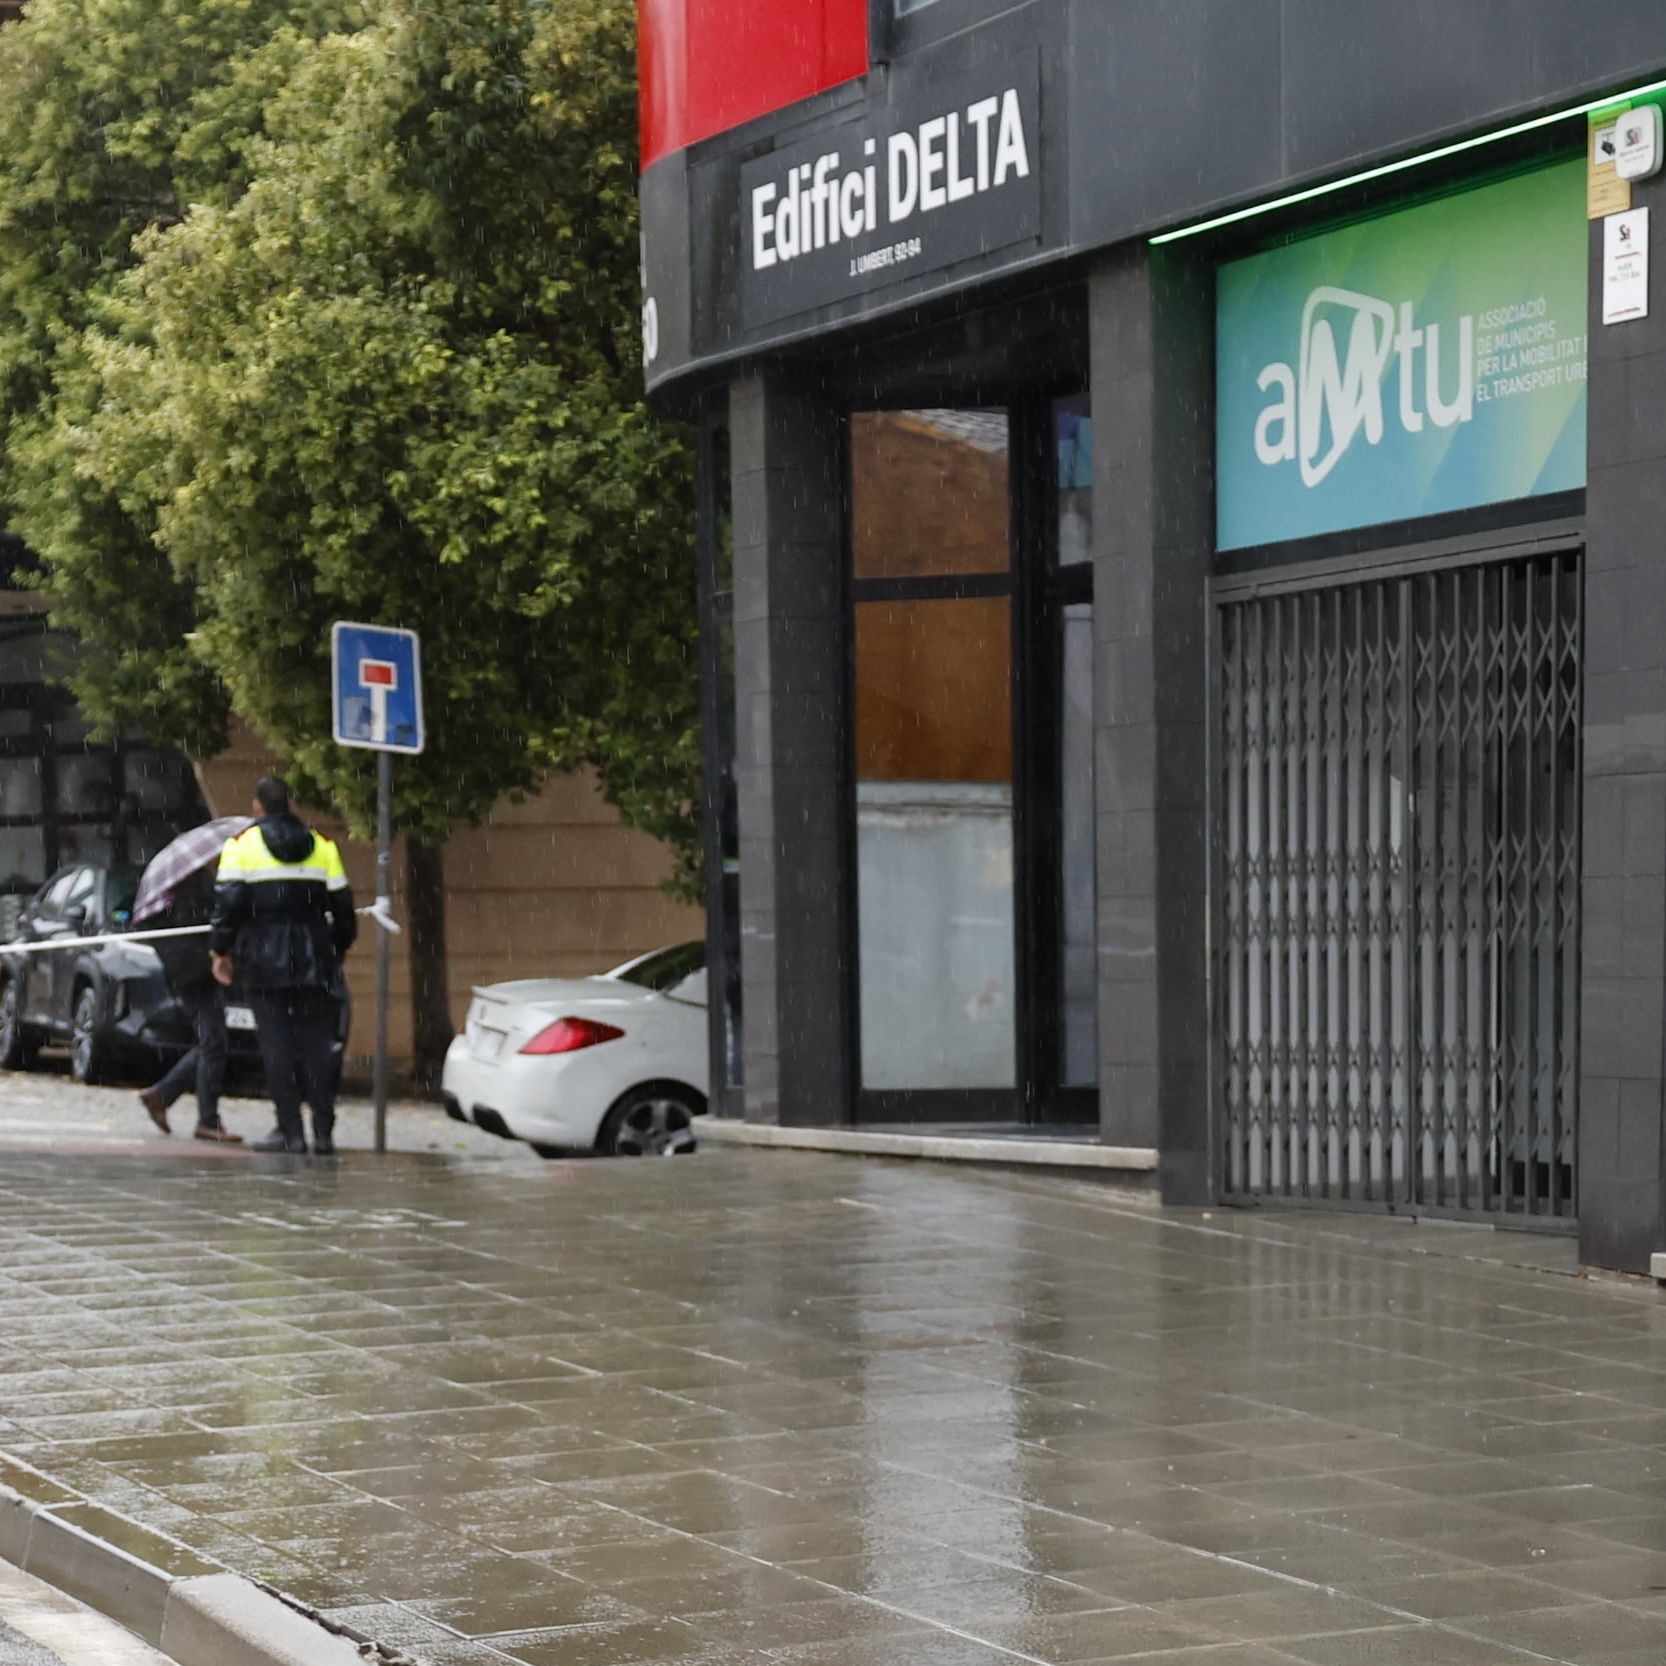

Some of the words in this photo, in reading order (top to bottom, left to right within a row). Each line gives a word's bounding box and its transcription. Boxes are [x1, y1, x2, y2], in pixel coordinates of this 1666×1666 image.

[752, 138, 877, 270] Edifici
[887, 88, 1030, 223] DELTA
[1478, 294, 1546, 330] ASSOCIACIÓ
[1476, 335, 1492, 356] DE
[1496, 320, 1555, 350] MUNICIPIS
[1476, 356, 1500, 377] PER
[1502, 353, 1518, 372] LA
[1520, 337, 1581, 366] MOBILITAT
[1476, 383, 1492, 402] EL
[1494, 366, 1563, 398] TRANSPORT
